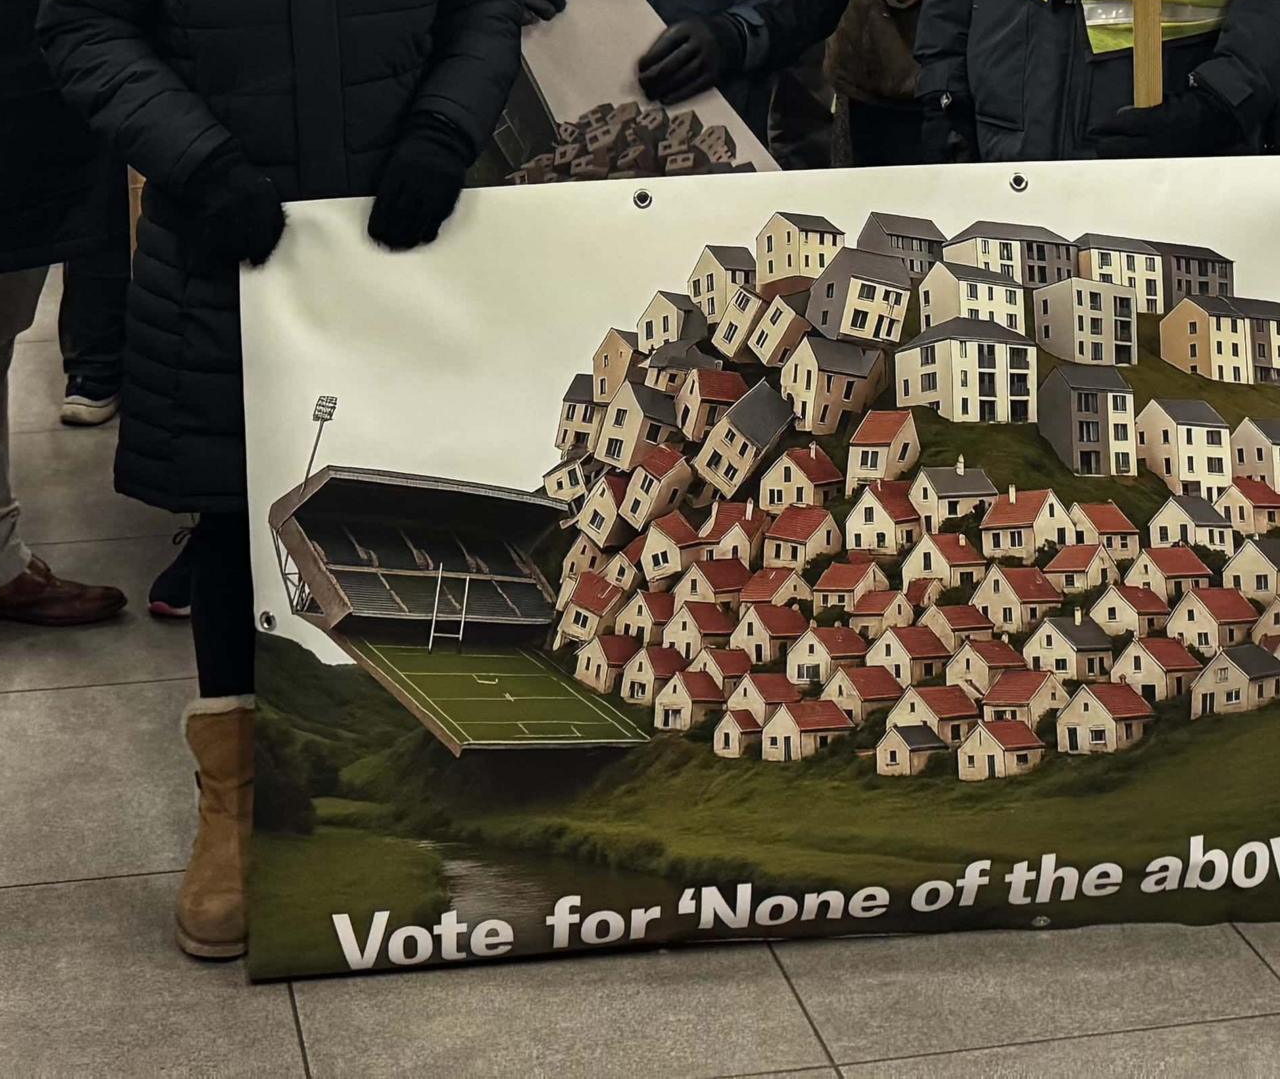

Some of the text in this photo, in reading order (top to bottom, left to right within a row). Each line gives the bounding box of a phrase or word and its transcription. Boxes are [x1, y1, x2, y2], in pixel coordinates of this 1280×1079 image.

[332, 909, 515, 971] Vote
[545, 894, 662, 949] for
[677, 882, 890, 929] ‘None
[910, 858, 993, 913] of
[1004, 853, 1124, 905] the
